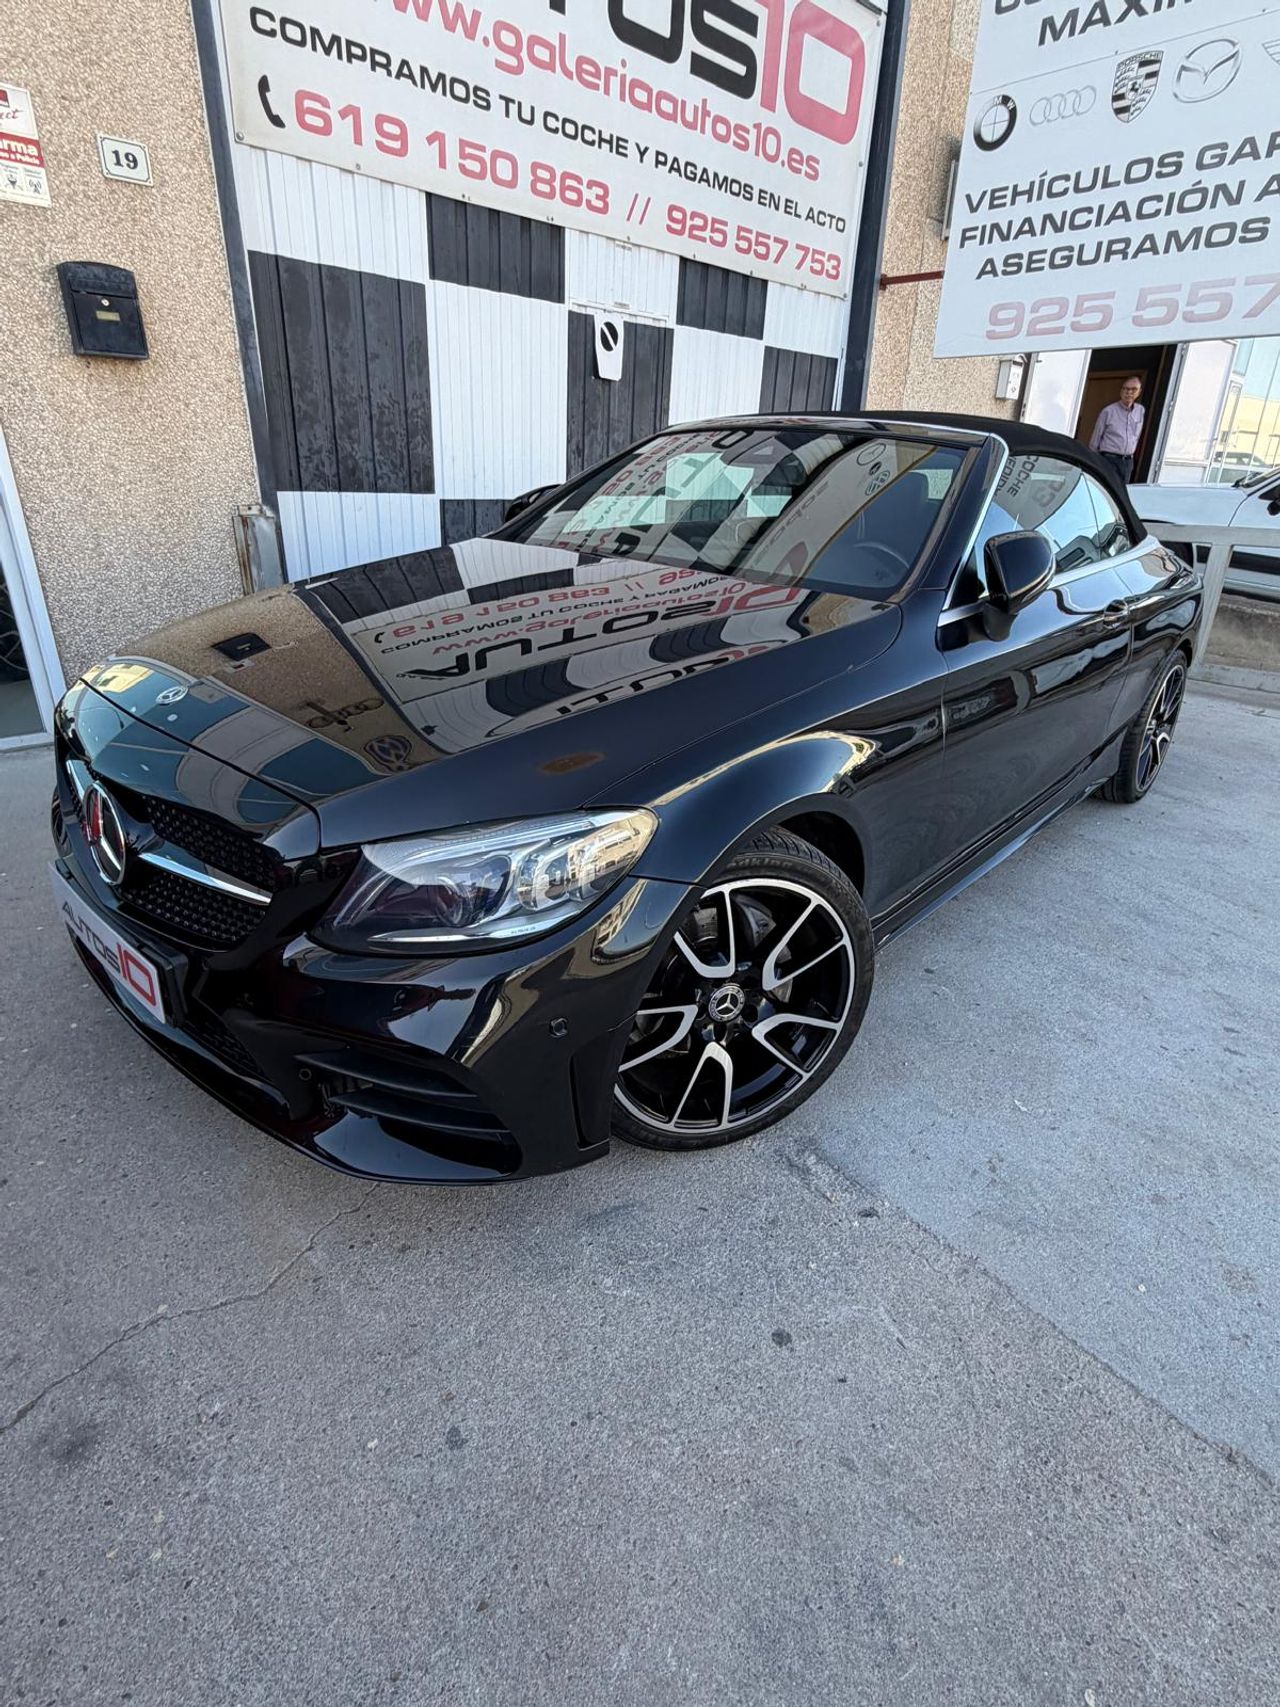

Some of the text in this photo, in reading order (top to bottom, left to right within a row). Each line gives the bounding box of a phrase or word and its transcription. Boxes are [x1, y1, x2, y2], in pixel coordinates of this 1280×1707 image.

[249, 6, 846, 234] COMPRAMOS TU COCHE Y PAGAMOS EN EL ACTO
[111, 149, 139, 170] 19
[294, 89, 409, 158] 619
[425, 130, 519, 190] 150
[530, 160, 610, 216] 863
[665, 203, 729, 249] 925
[734, 224, 789, 265] 557
[794, 242, 842, 282] 753
[965, 150, 1185, 214] VEHÍCULOS
[959, 179, 1246, 249] FINANCIACIÓN
[976, 216, 1271, 280] ASEGURAMOS
[985, 272, 1280, 341] 925 557
[62, 901, 156, 1006] AUTOS10
